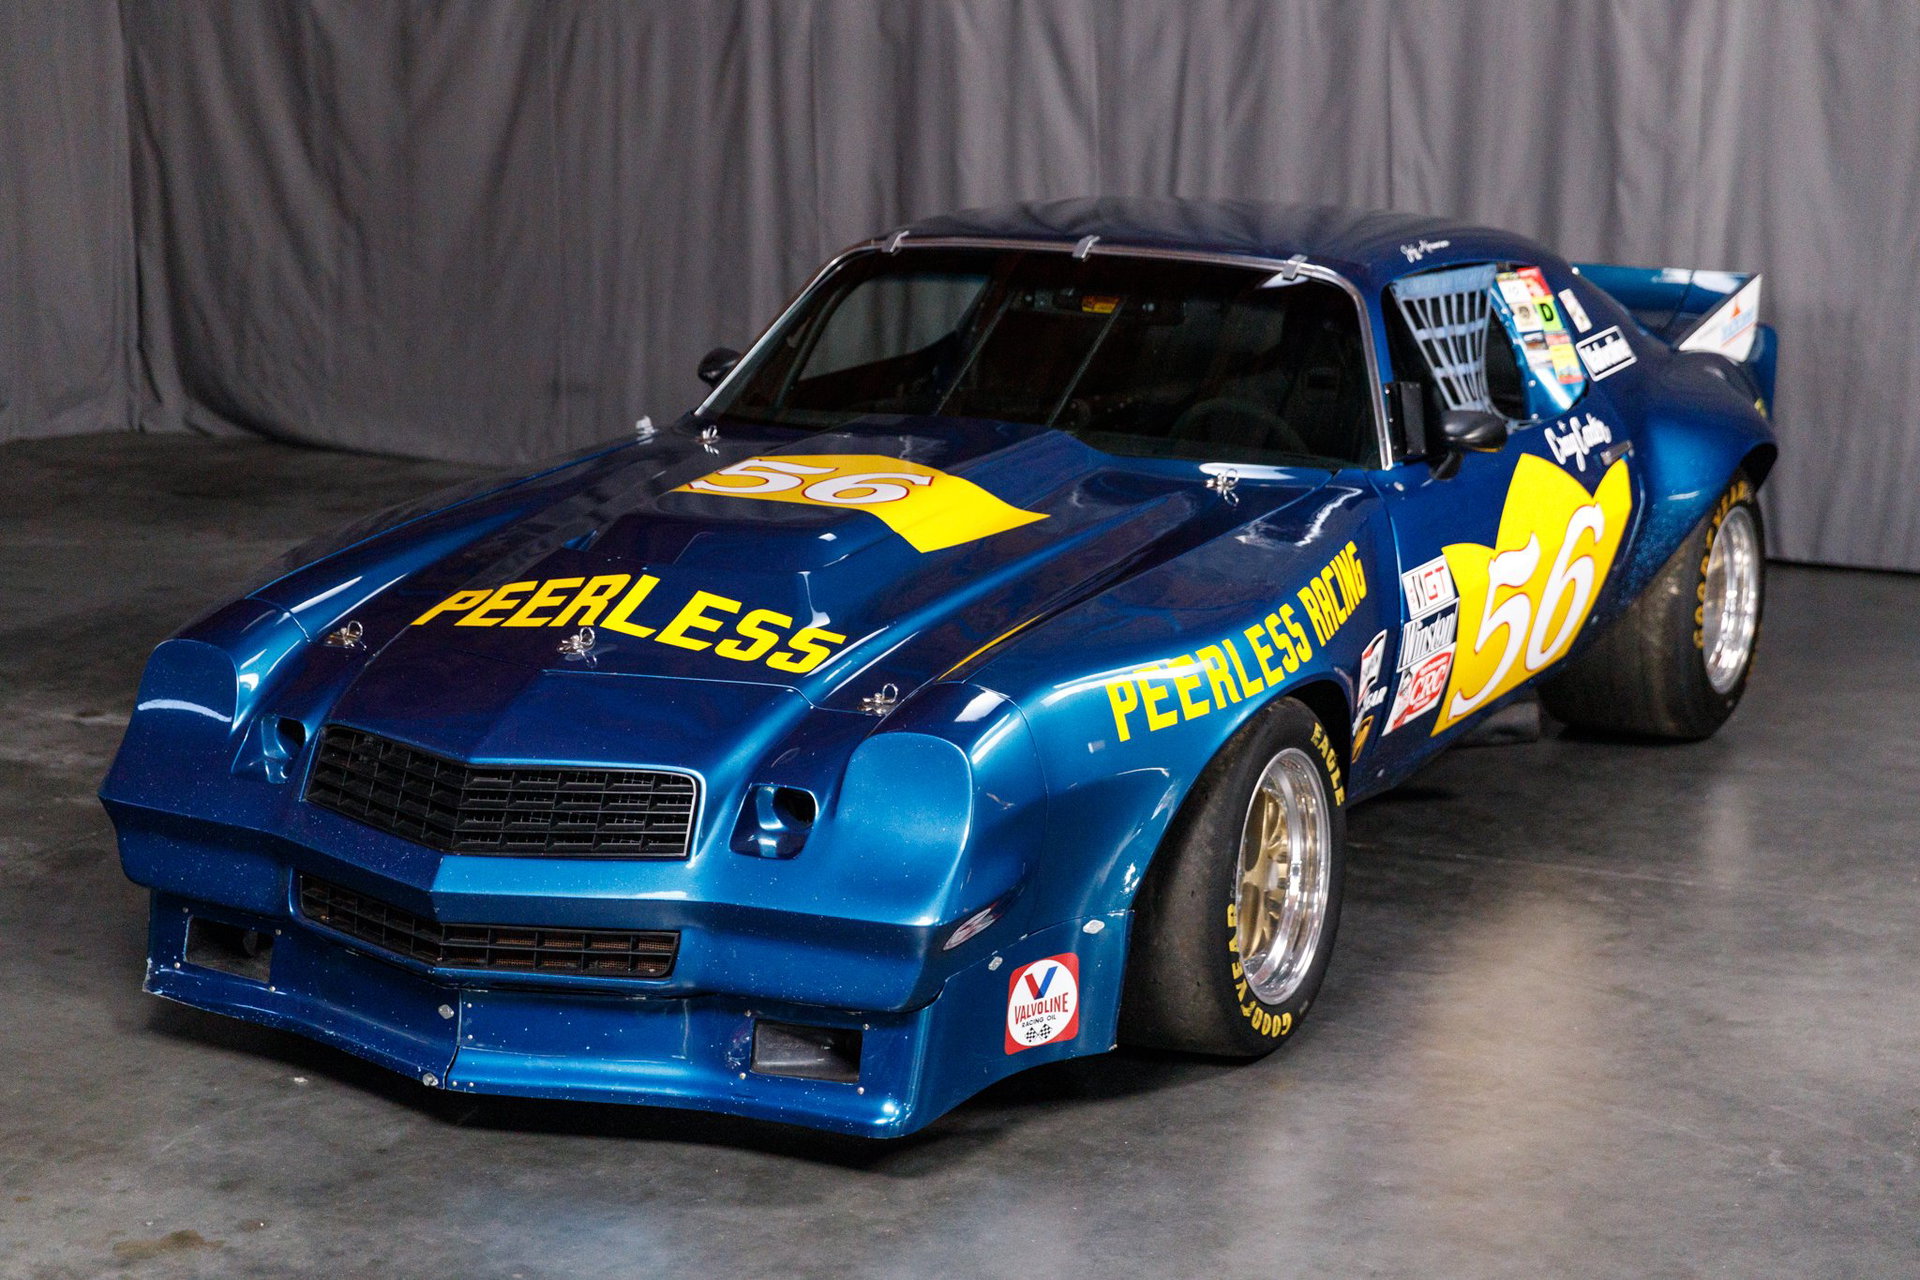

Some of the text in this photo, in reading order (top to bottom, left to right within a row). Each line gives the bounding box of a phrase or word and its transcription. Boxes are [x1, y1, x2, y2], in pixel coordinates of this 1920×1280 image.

[1539, 303, 1554, 322] D
[687, 456, 936, 505] 56
[1424, 565, 1447, 601] GT
[410, 573, 847, 674] PEERLESS
[1447, 502, 1606, 721] 56
[1104, 540, 1368, 742] PEERLESS RACING
[1402, 612, 1456, 666] Winston
[1409, 664, 1446, 706] CRC
[1310, 722, 1346, 807] EAGLE
[1014, 992, 1069, 1025] VALVOLINE
[1021, 1014, 1057, 1028] RACING OIL
